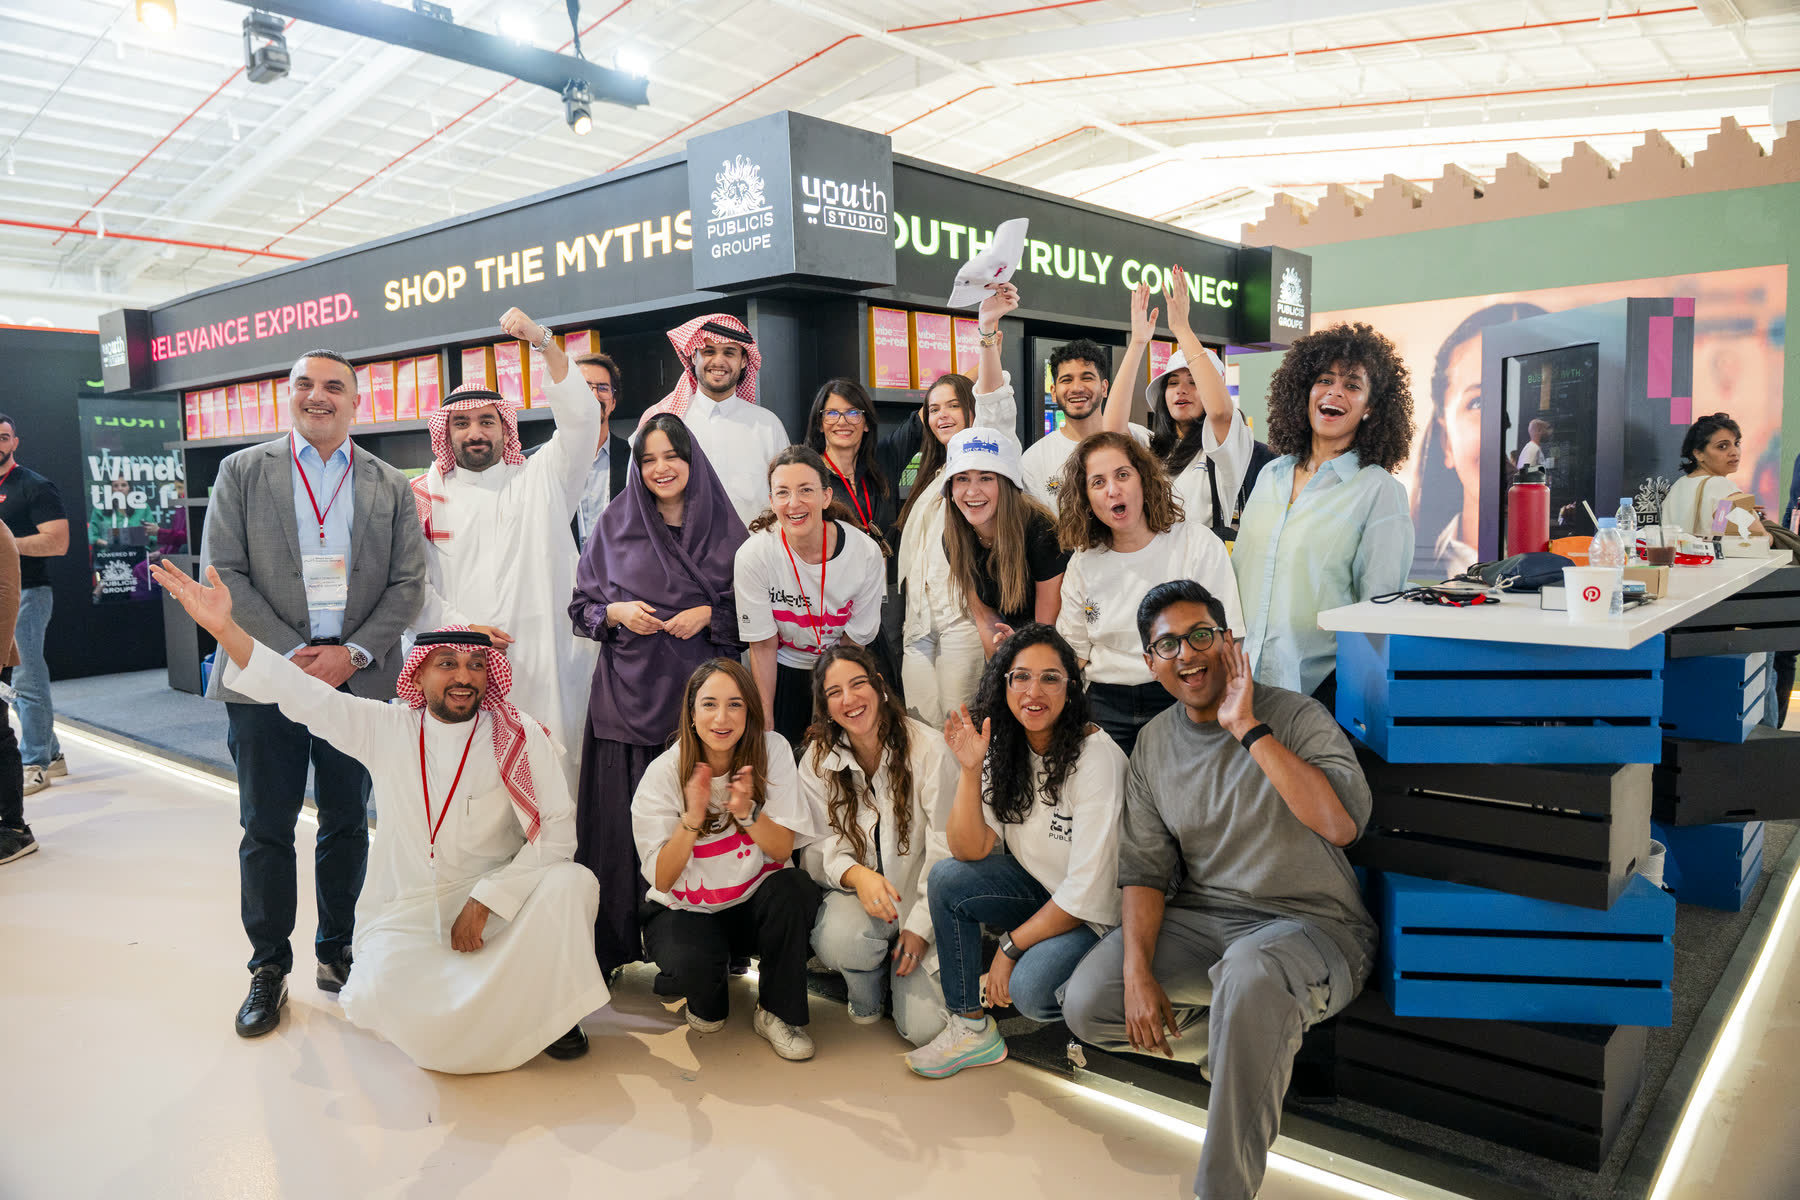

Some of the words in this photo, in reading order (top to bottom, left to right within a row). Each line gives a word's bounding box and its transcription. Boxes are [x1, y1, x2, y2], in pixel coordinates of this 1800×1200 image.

[801, 175, 887, 214] youth
[707, 211, 774, 239] PUBLICIS
[828, 210, 883, 231] STUDIO
[711, 233, 772, 259] GROUPE
[384, 265, 467, 312] SHOP
[474, 246, 545, 292] THE
[556, 209, 693, 277] MYTHS
[1016, 237, 1114, 285] RULY
[1121, 258, 1239, 308] CONNEC
[254, 292, 359, 339] EXPIRED.
[1276, 302, 1305, 318] PUBLICIS
[875, 325, 893, 337] vibe
[1278, 316, 1304, 330] GROUPE
[918, 329, 936, 340] vibe
[956, 344, 981, 355] ce-re
[91, 484, 148, 510] the
[100, 578, 138, 587] PUBLICIS
[102, 586, 137, 594] GROUPE
